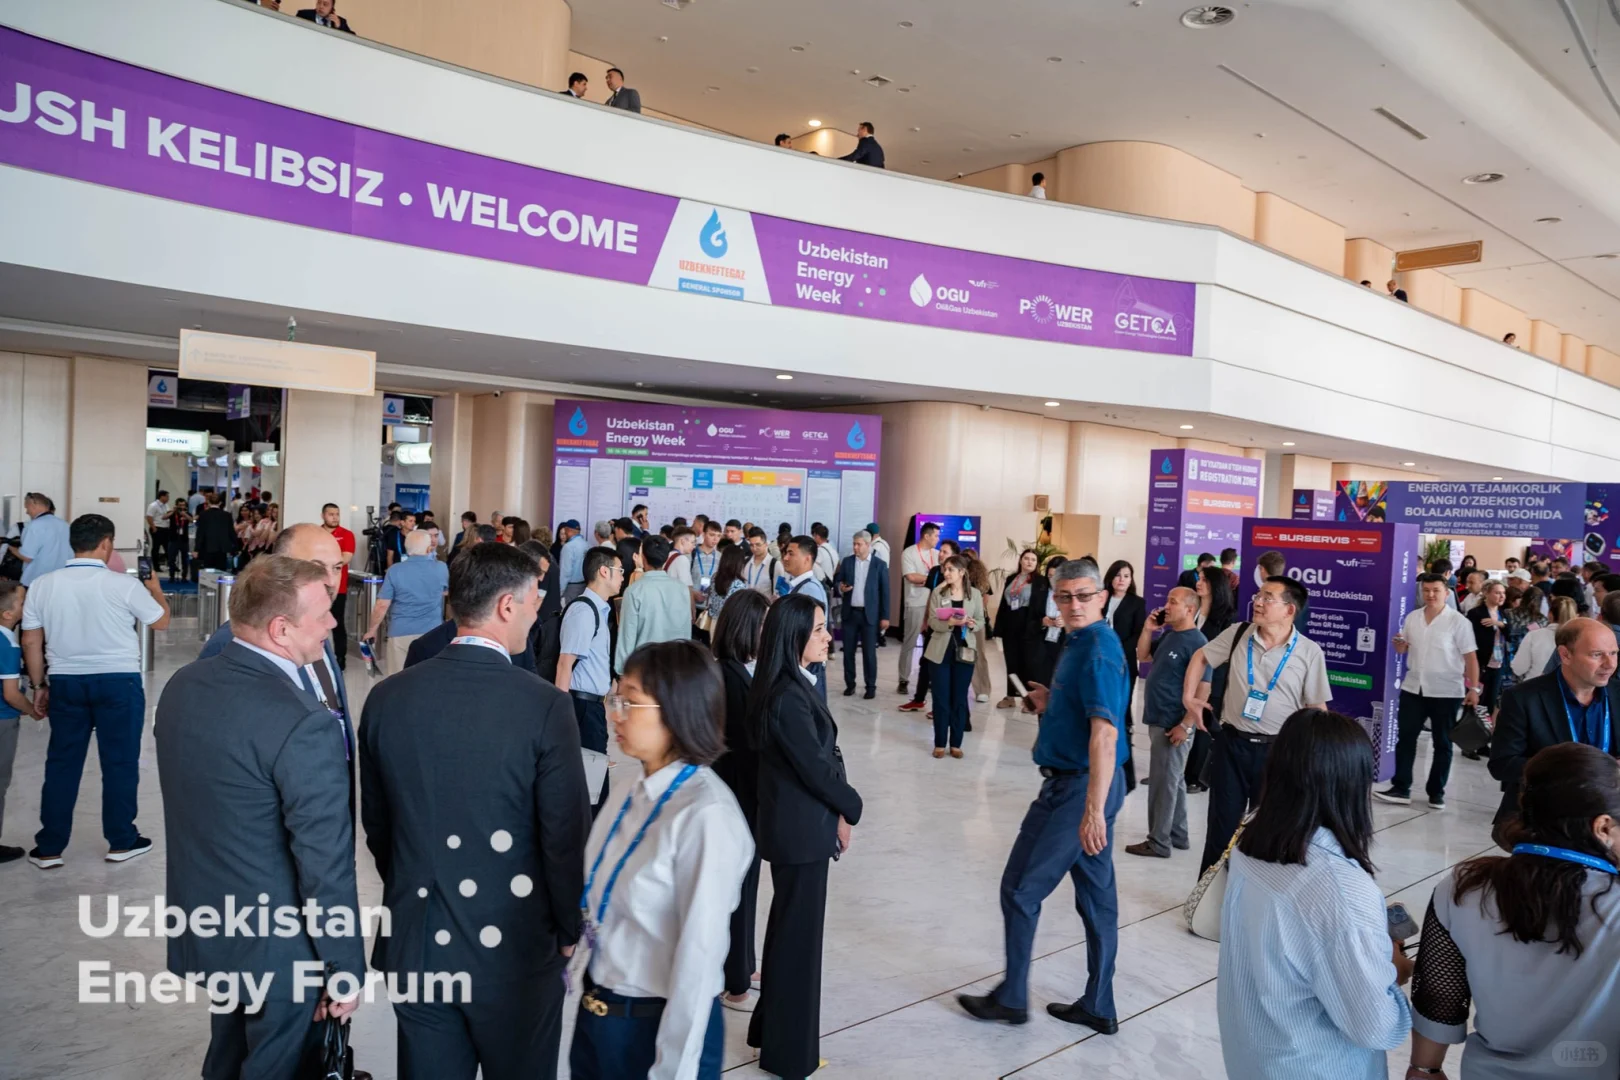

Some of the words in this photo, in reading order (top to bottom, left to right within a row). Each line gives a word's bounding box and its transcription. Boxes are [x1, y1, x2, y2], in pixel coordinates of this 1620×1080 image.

[148, 117, 384, 207] KELIBSIZ
[427, 182, 639, 254] WELCOME
[798, 239, 889, 269] Uzbekistan
[679, 259, 746, 280] UZBEKNEFTEGAZ
[797, 261, 855, 288] Energy
[681, 282, 711, 292] GENERAL
[711, 286, 741, 297] SPONSOR
[796, 283, 842, 305] Week
[936, 286, 970, 304] OGU
[936, 302, 962, 314] Oil&Gas
[963, 306, 998, 318] Uzbekistan
[1019, 295, 1093, 324] POWER
[1057, 320, 1092, 331] UZBEKISTAN
[1114, 312, 1177, 336] GETCA
[606, 417, 675, 432] Uzbekistan
[605, 432, 649, 447] Energy
[651, 434, 686, 446] Week
[1199, 470, 1242, 485] REGISTRATION
[1242, 475, 1257, 487] ZONE
[1408, 483, 1467, 493] ENERGIYA
[1470, 483, 1562, 494] TEJAMKORLIK
[1421, 495, 1457, 505] YANGI
[1459, 496, 1545, 506] O'ZBEKISTON
[1404, 507, 1494, 518] BOLALARINING
[1497, 510, 1563, 520] NIGOHIDA
[1453, 521, 1493, 529] EFFICIENCY
[1279, 533, 1351, 544] BURSERVIS
[1287, 566, 1333, 586] OGU
[1323, 588, 1374, 602] Uzbekistan
[1328, 613, 1344, 621] olish
[1309, 628, 1344, 639] skanerlang
[1327, 650, 1347, 659] badge
[1336, 643, 1352, 651] code
[1330, 674, 1367, 685] Uzbekistan
[1386, 699, 1394, 753] Uzbekistan
